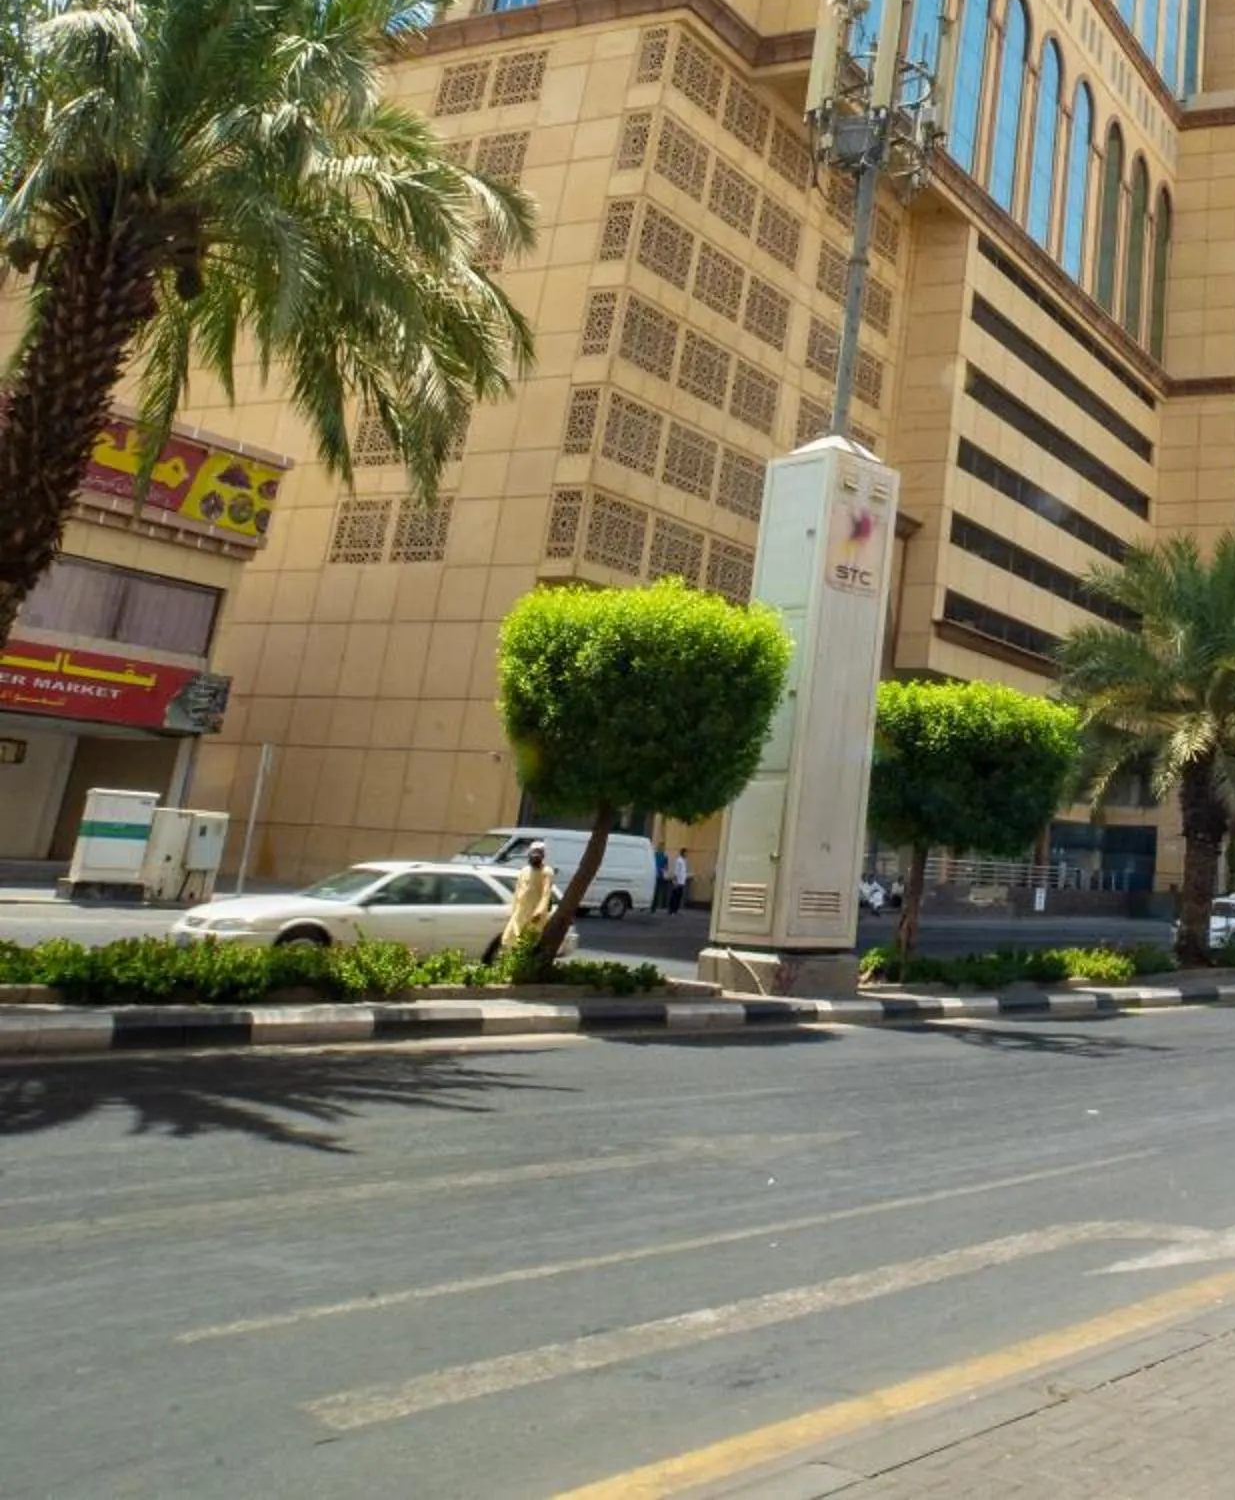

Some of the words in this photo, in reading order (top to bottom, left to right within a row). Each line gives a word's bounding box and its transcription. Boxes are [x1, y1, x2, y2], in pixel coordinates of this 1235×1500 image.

[835, 564, 873, 586] STC
[0, 672, 27, 686] ER
[33, 678, 121, 699] MARKET
